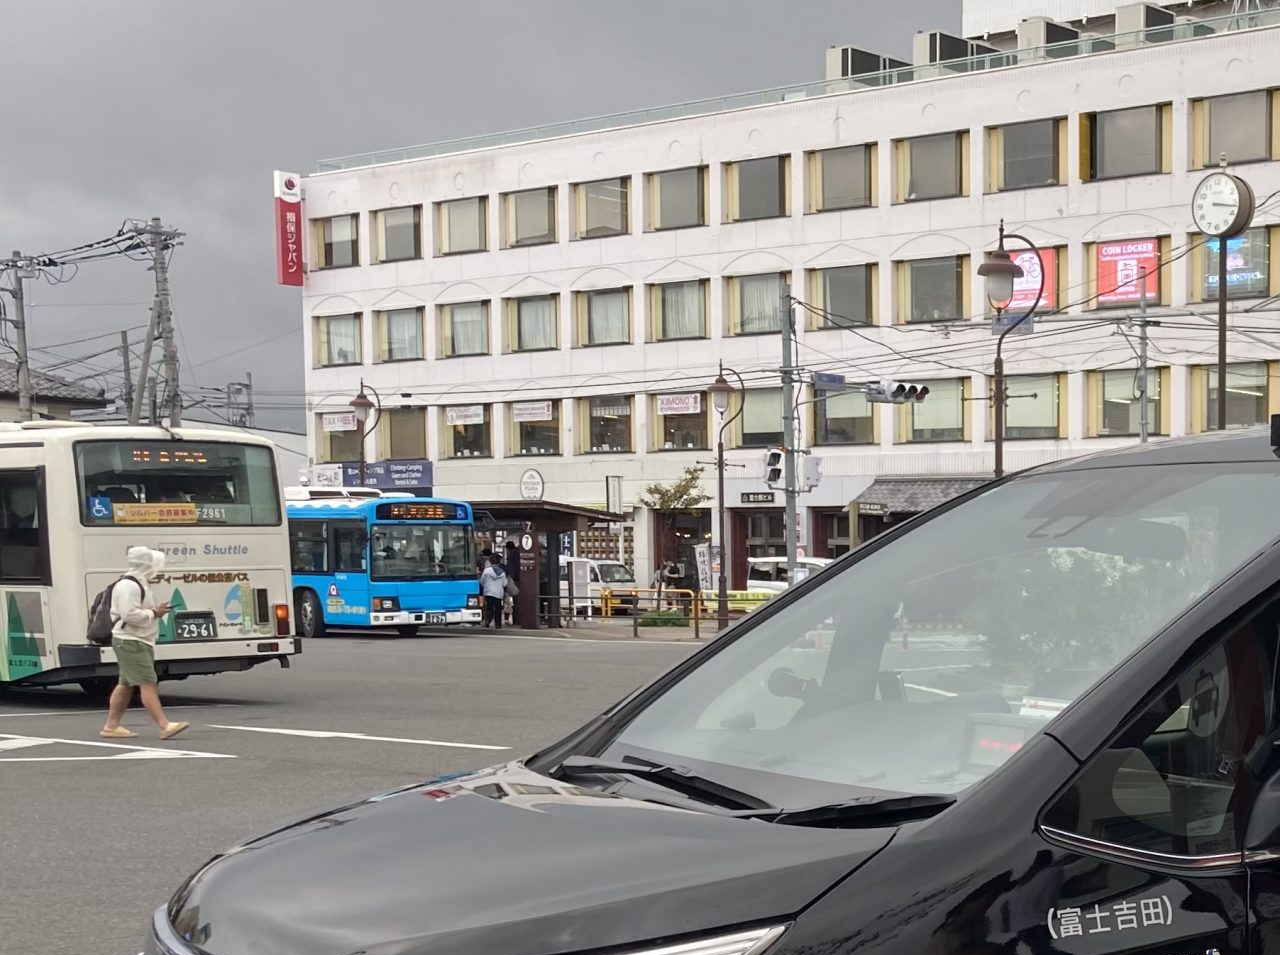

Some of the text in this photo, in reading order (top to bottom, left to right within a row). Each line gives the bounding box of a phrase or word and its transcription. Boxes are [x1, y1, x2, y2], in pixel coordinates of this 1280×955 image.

[286, 211, 298, 273] 損保ジャパン
[1102, 243, 1153, 256] COIN LOCKER
[203, 544, 248, 556] Shuttle
[1047, 895, 1173, 940] (富士吉田)
